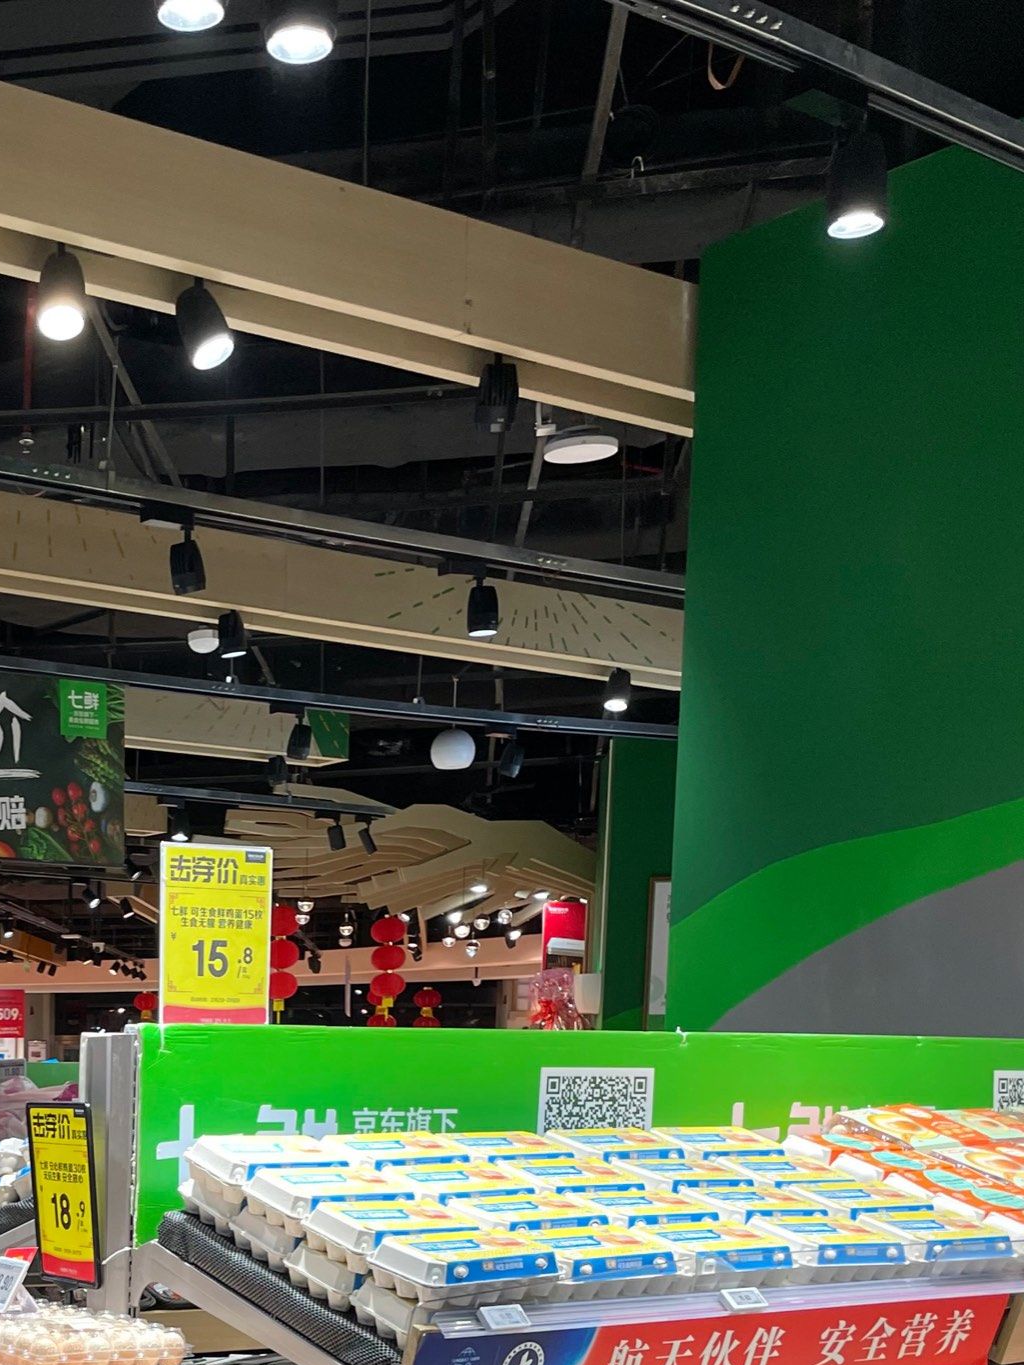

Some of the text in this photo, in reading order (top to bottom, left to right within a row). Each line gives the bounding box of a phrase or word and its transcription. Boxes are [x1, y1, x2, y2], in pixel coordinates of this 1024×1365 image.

[67, 690, 100, 711] 七鲜
[170, 855, 238, 885] 击穿价
[32, 1112, 71, 1140] 击穿价
[352, 1107, 460, 1134] 京东旗下
